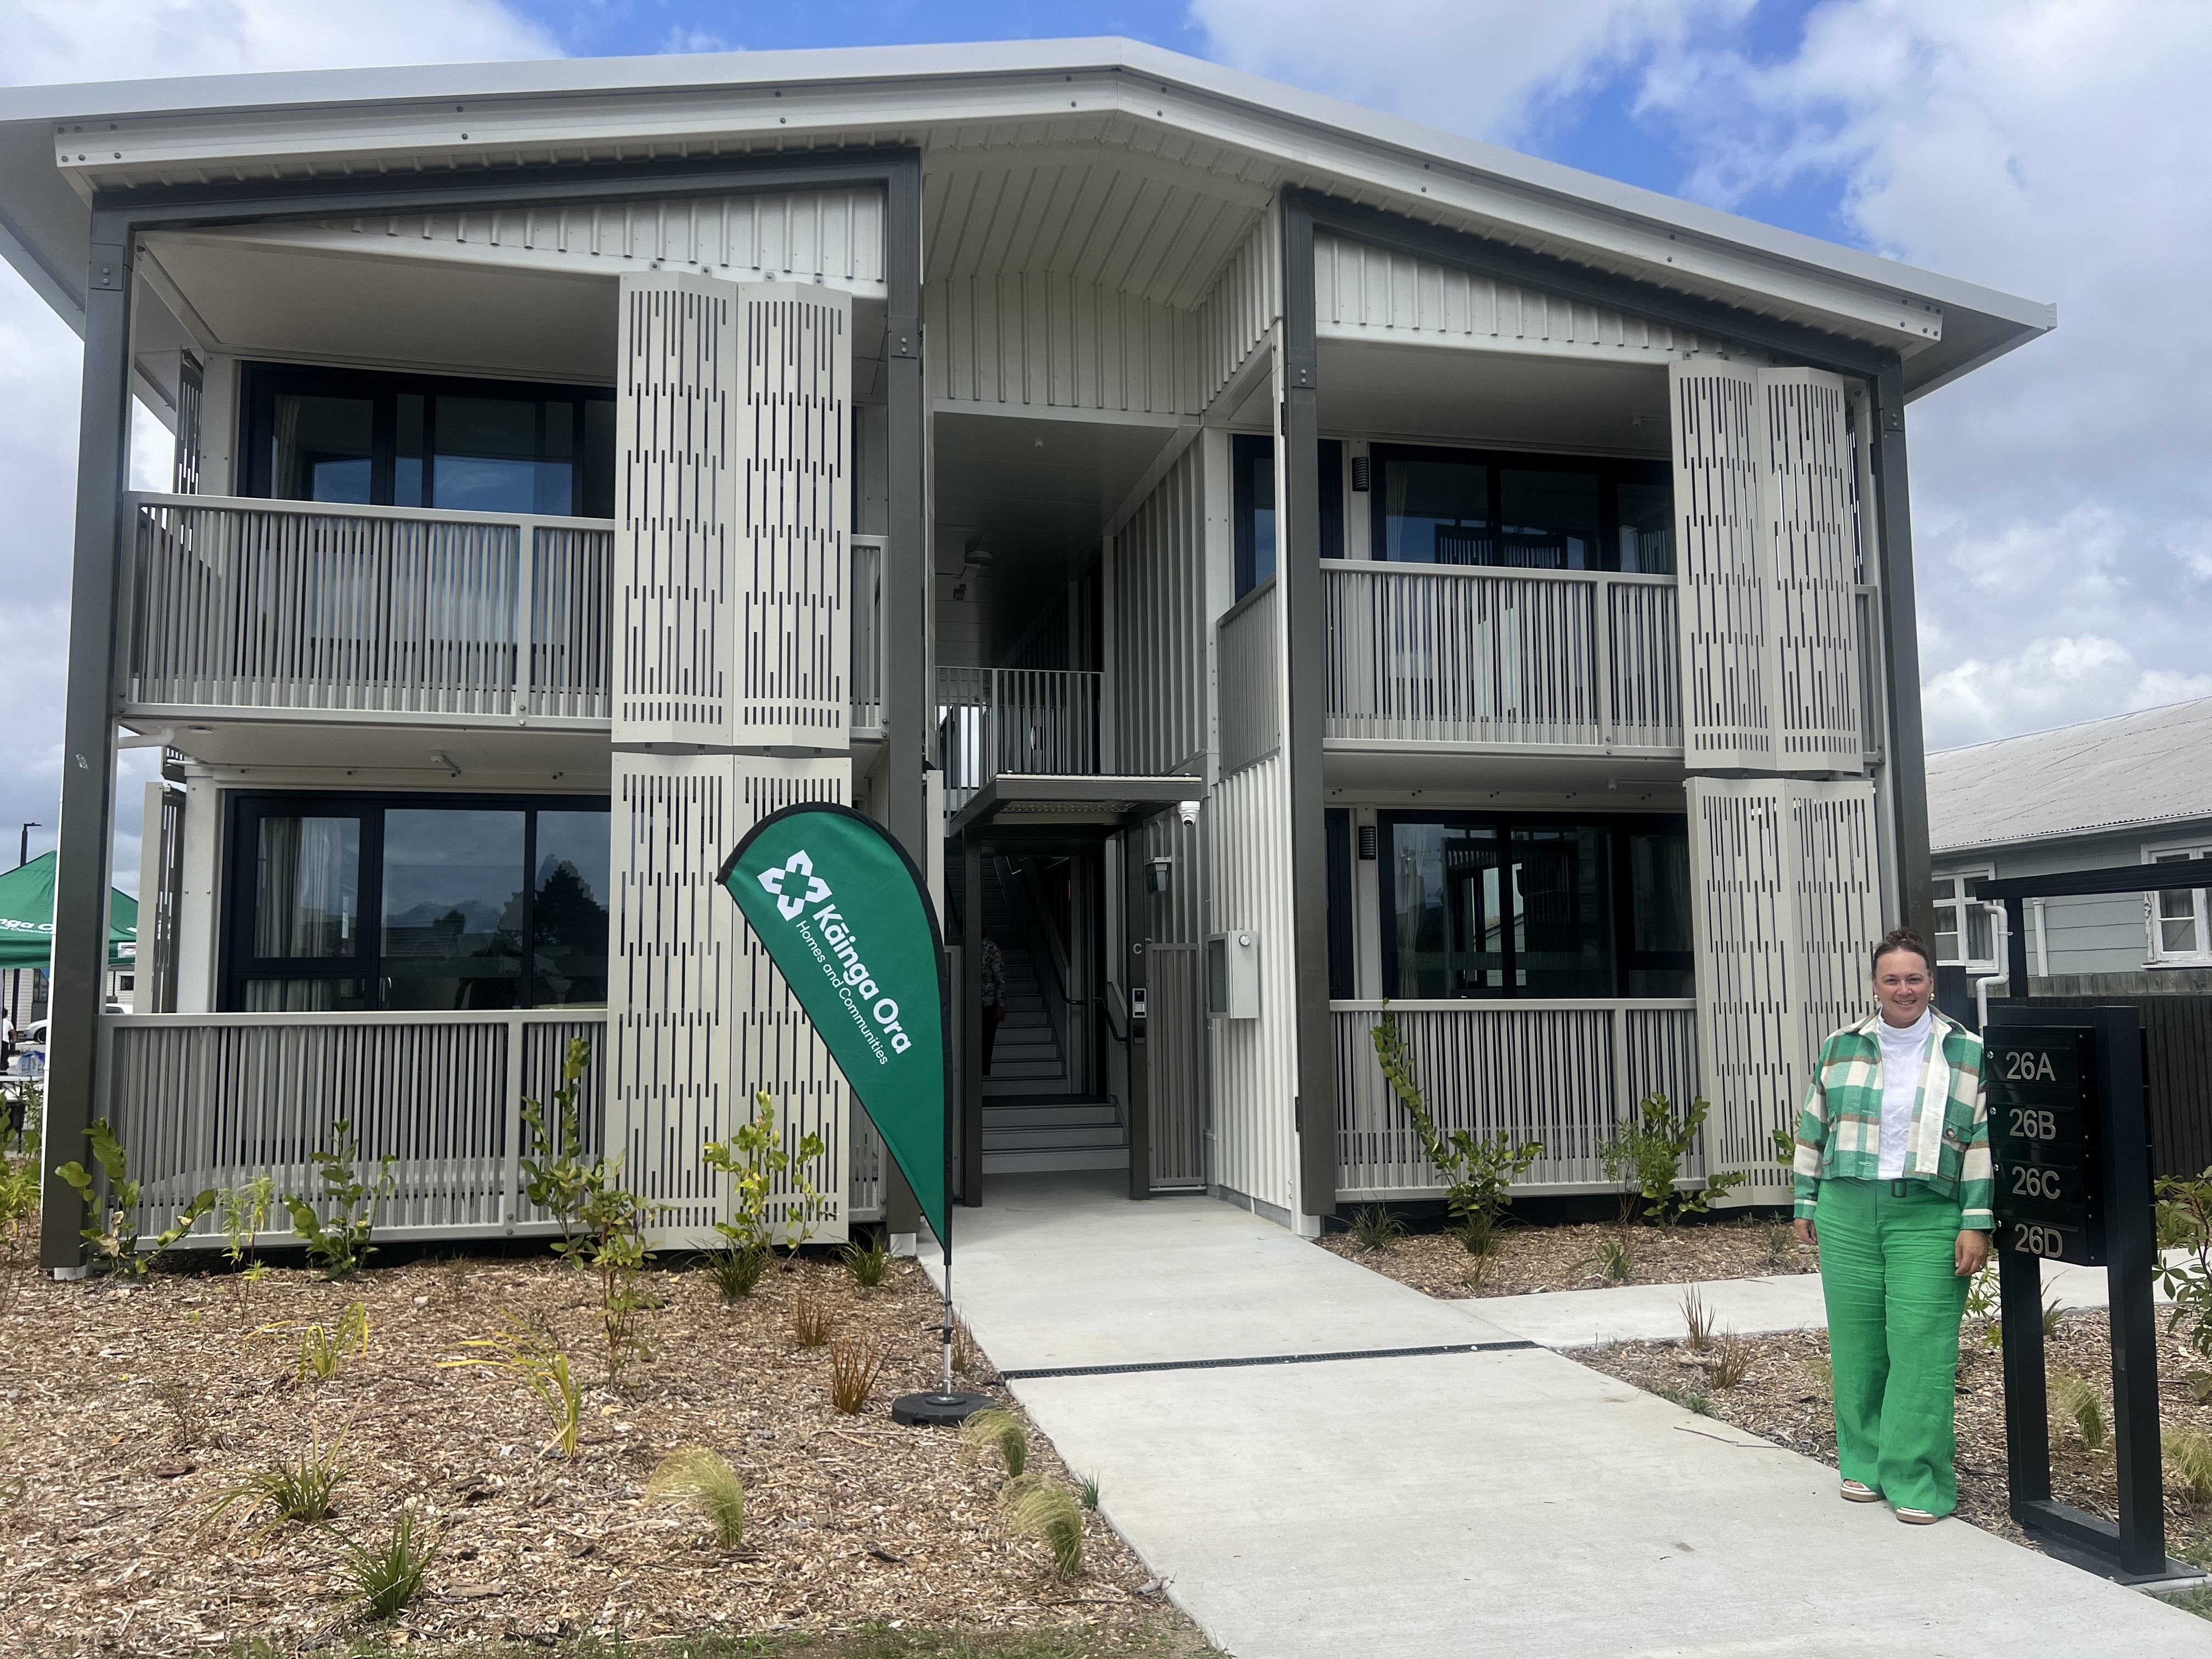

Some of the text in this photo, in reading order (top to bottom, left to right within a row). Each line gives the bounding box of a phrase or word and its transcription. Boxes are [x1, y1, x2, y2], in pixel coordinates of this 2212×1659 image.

[1133, 943, 1143, 955] C
[795, 920, 888, 1065] Homes and Communities
[812, 904, 912, 1054] Kāinga Ora
[2006, 1052, 2056, 1081] 26A
[2009, 1108, 2056, 1139] 26B
[2012, 1166, 2061, 1199] 26C
[2015, 1223, 2063, 1259] 26D
